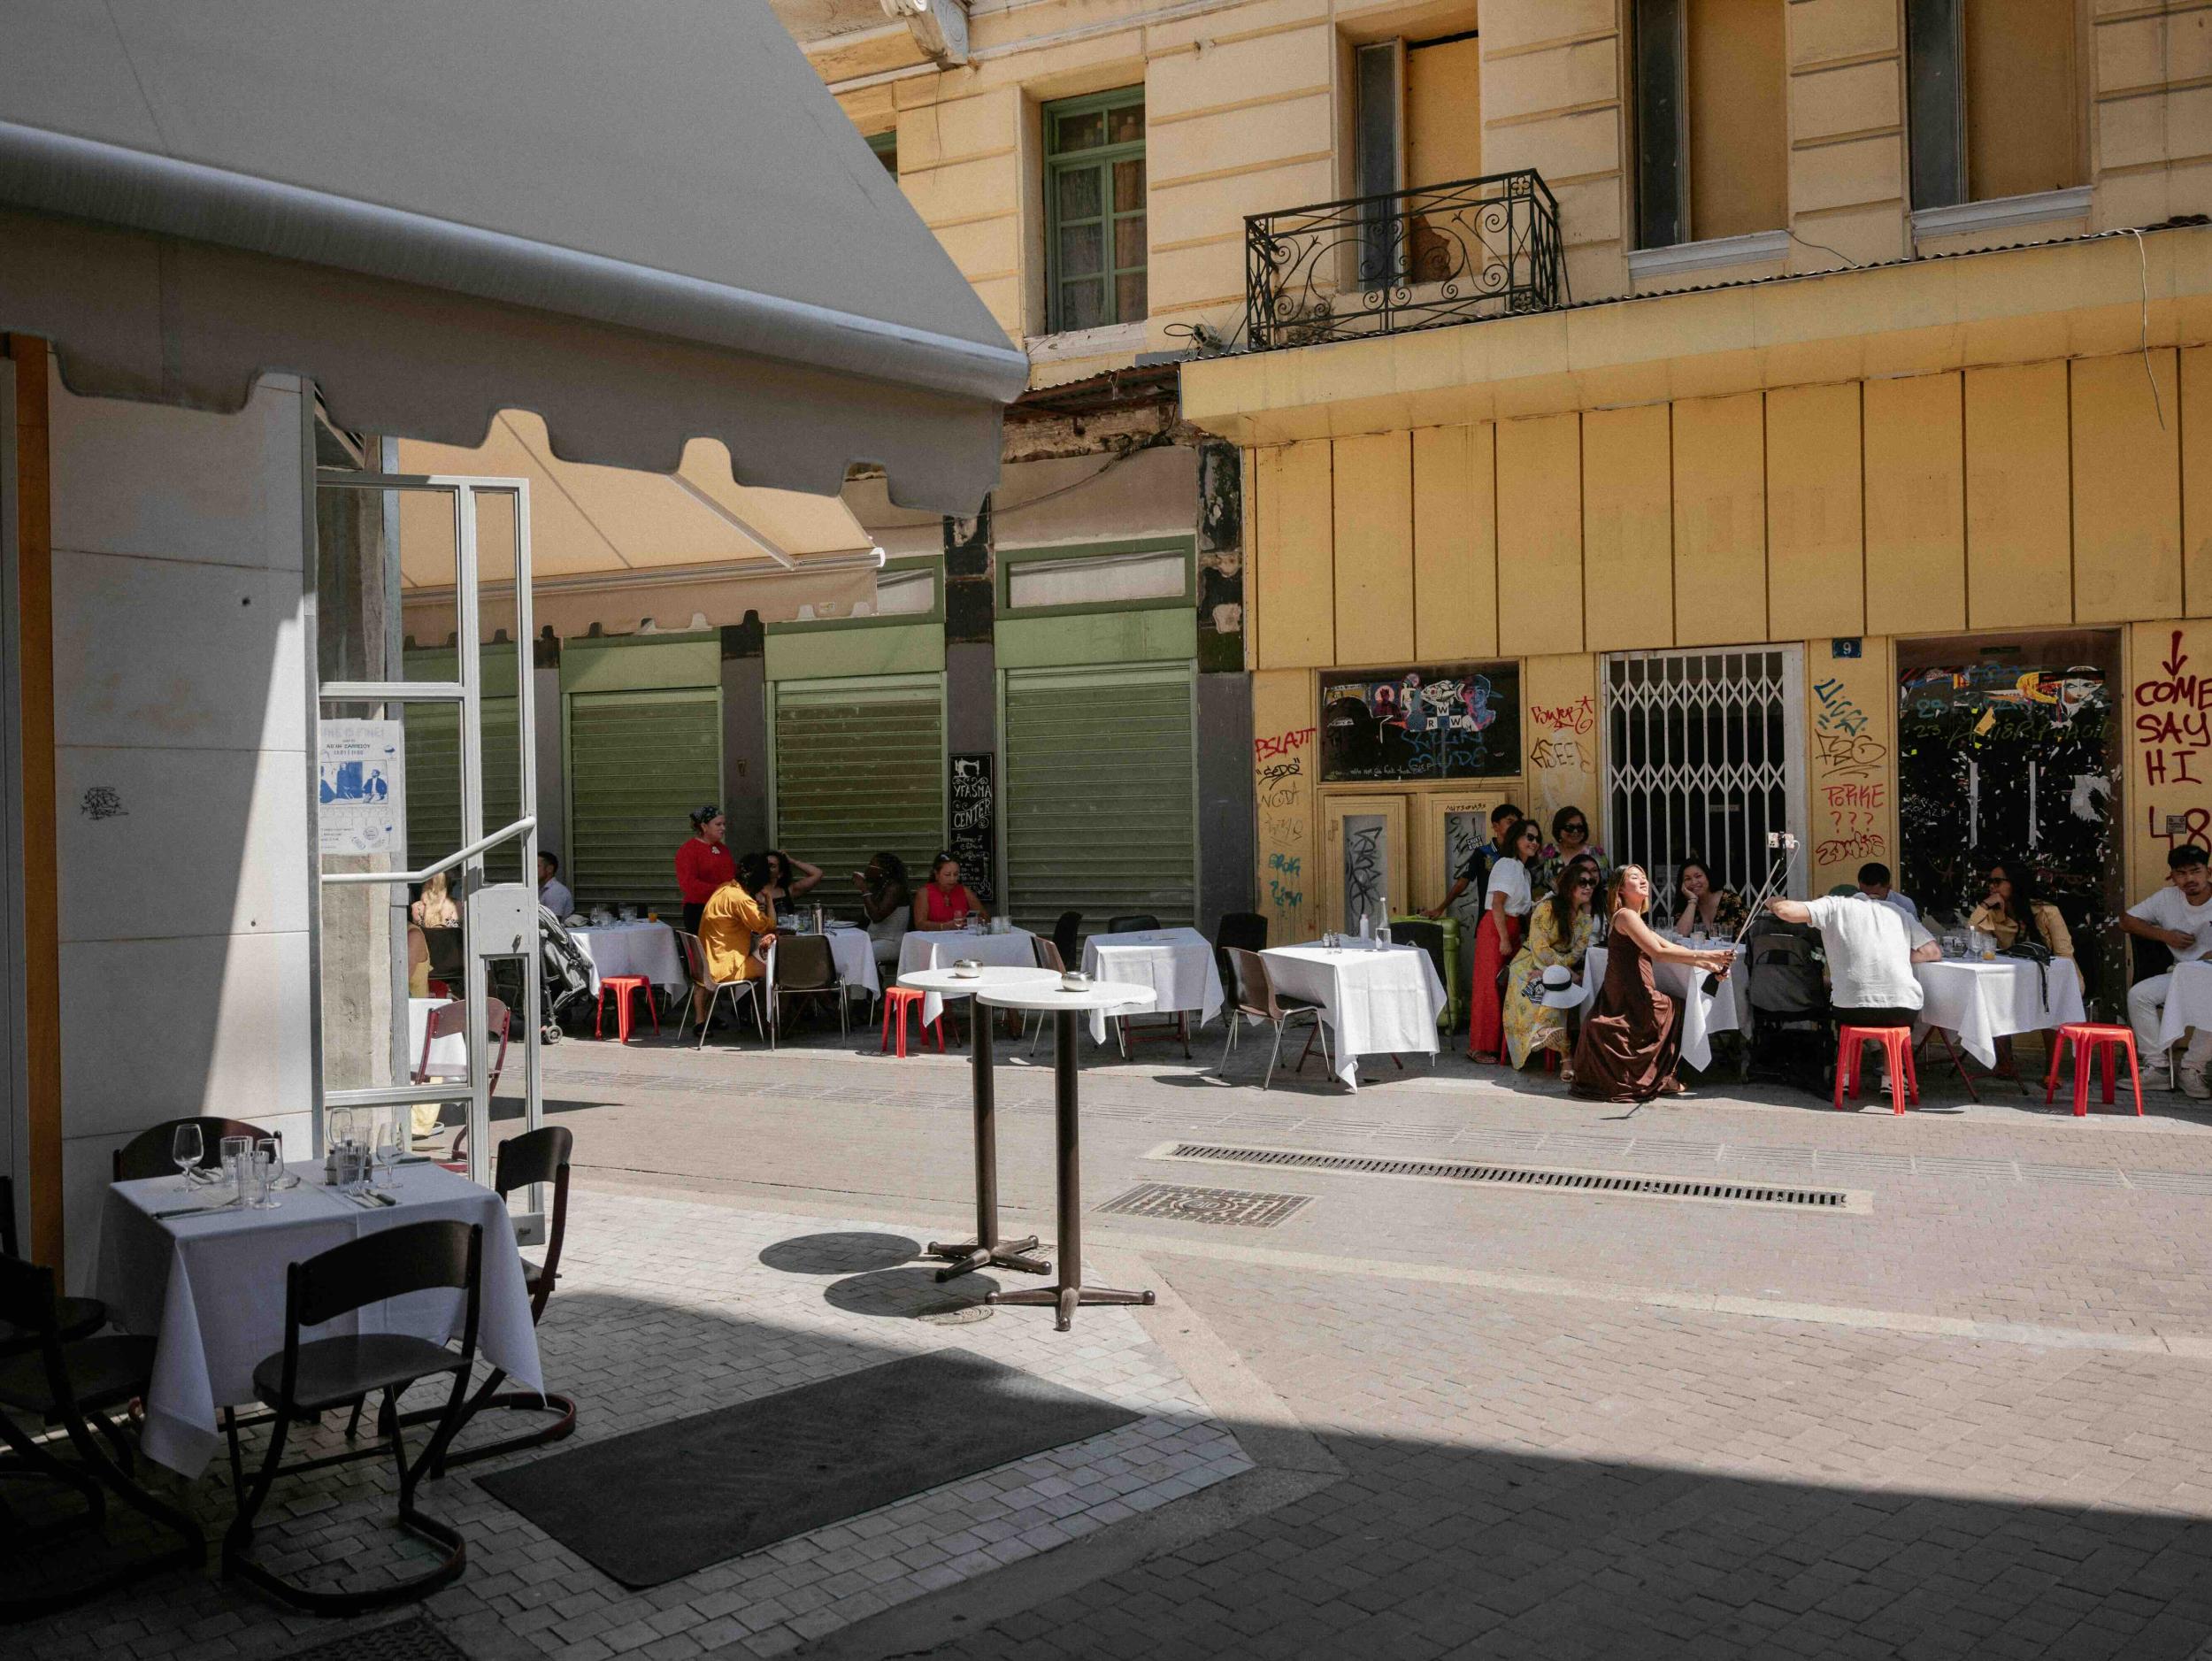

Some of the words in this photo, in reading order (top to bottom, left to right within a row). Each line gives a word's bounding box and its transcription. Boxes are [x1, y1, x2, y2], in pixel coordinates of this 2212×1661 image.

[1842, 642, 1852, 655] 9
[2135, 675, 2212, 711] COME
[2136, 711, 2210, 747] SAY
[2146, 749, 2201, 786] HI
[953, 785, 992, 797] YFASMA
[954, 800, 991, 827] CENTER
